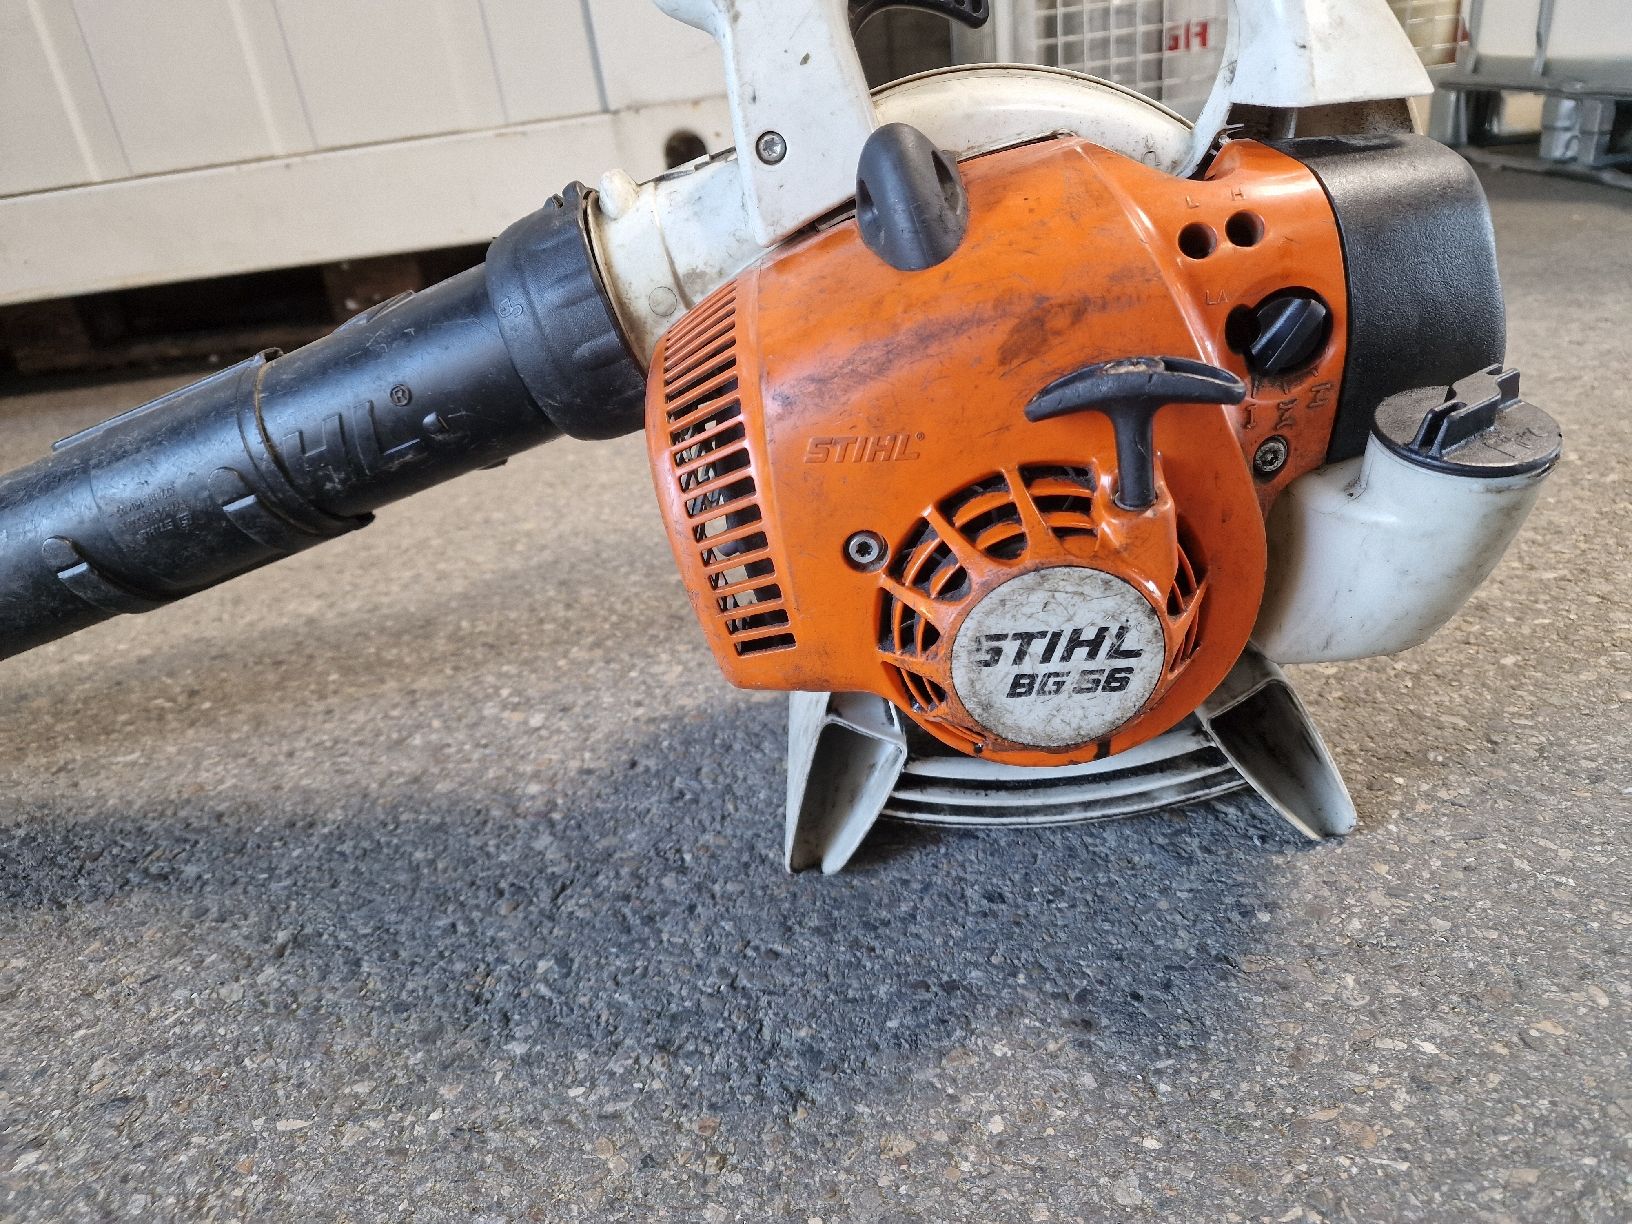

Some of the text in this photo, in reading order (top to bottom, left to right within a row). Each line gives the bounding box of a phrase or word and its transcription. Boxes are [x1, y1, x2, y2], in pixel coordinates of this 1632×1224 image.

[976, 625, 1143, 668] STIHL
[1006, 667, 1135, 698] BG 56
